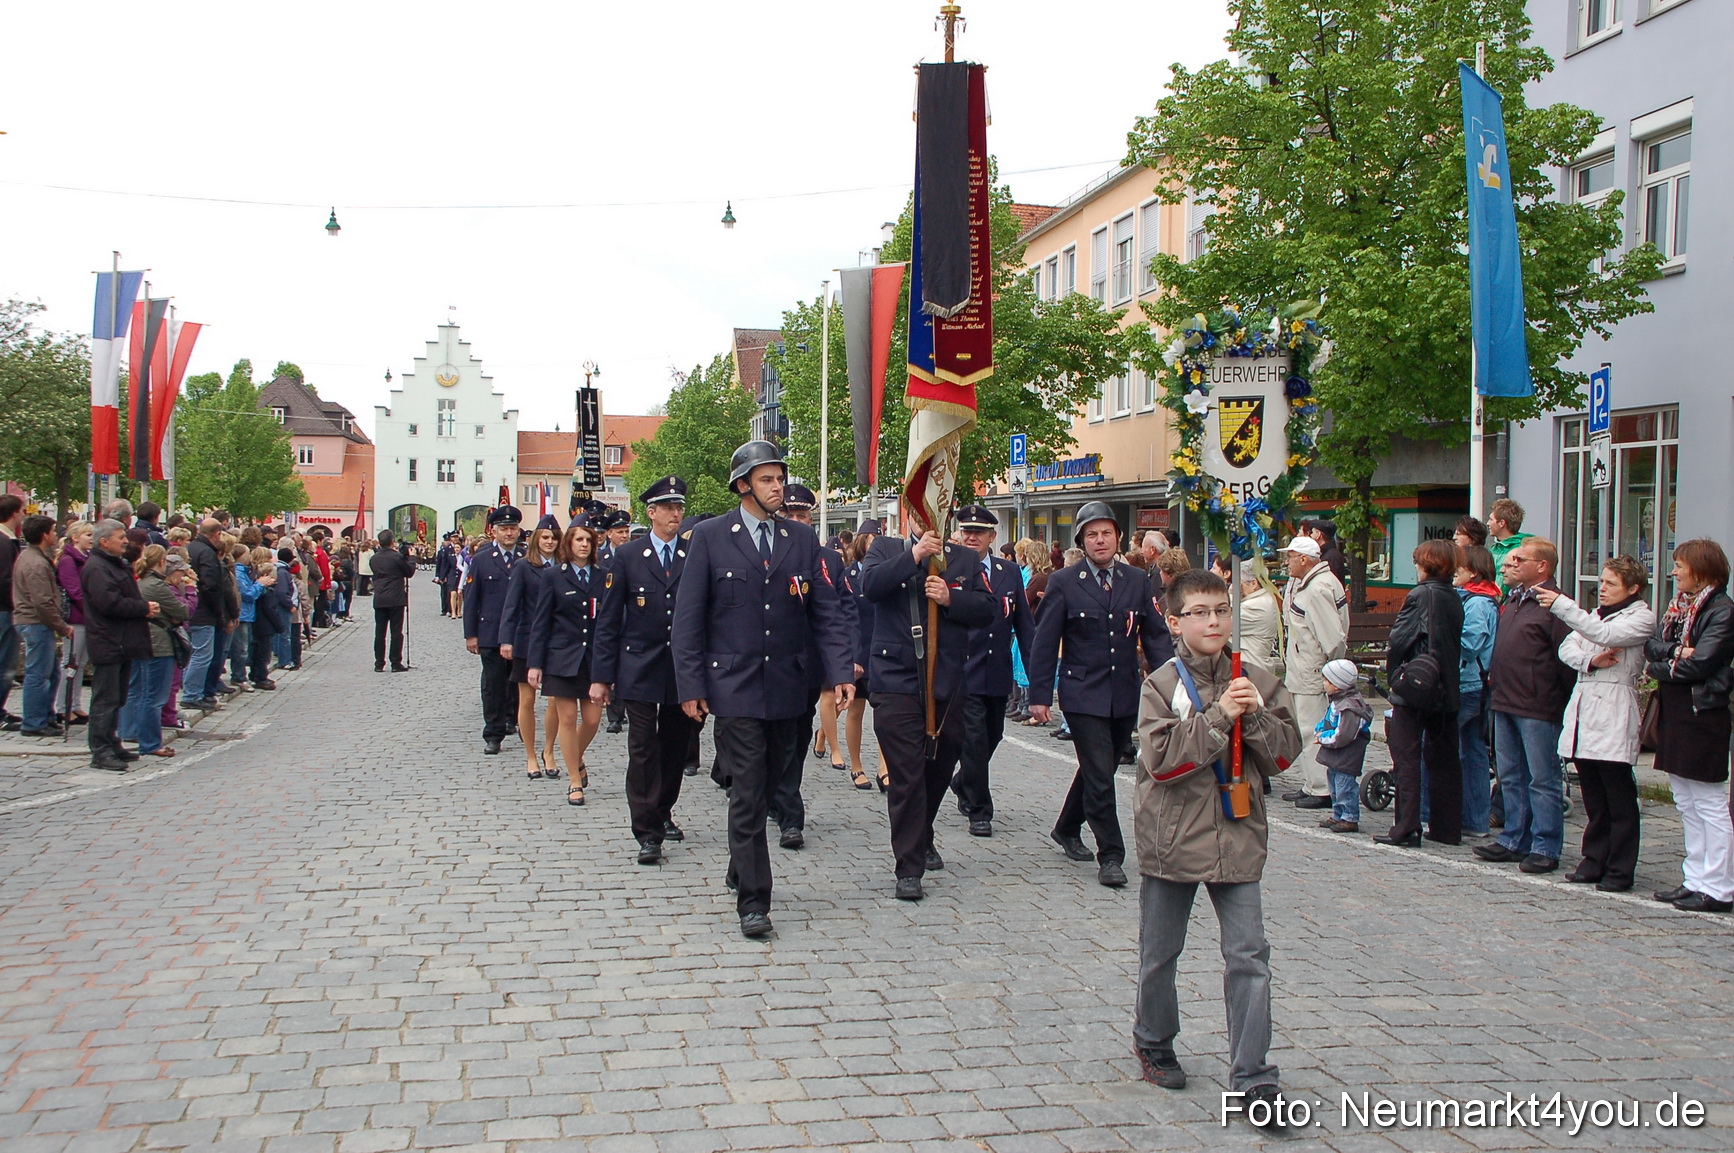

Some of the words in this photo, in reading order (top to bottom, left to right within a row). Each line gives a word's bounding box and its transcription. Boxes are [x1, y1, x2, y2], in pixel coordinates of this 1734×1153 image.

[964, 322, 986, 330] Michael
[1205, 365, 1288, 384] EUERWEHR
[1593, 377, 1605, 425] P
[1013, 438, 1023, 463] P
[298, 516, 341, 524] Sparkasse
[1424, 526, 1455, 540] Nide
